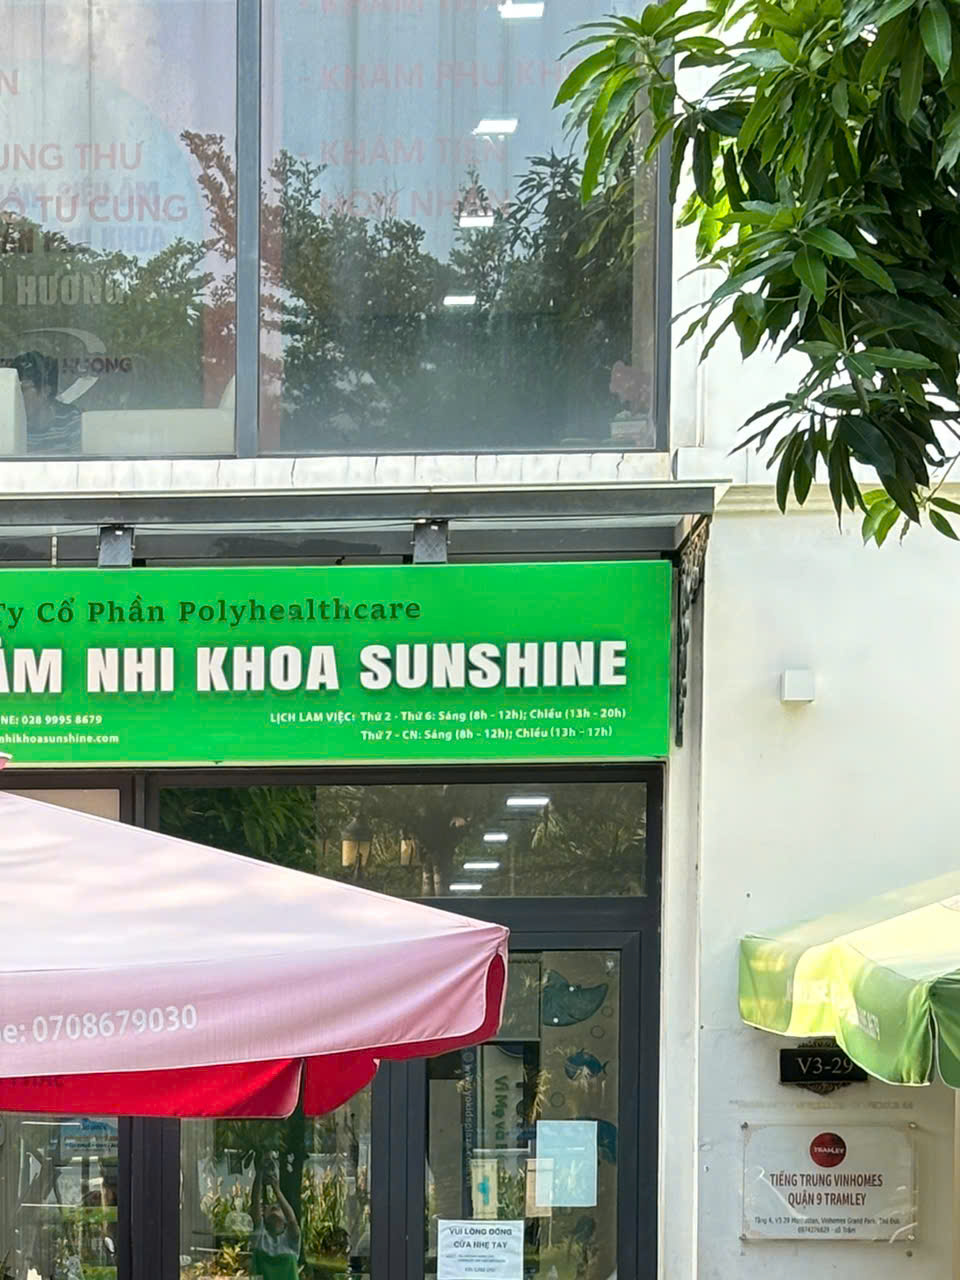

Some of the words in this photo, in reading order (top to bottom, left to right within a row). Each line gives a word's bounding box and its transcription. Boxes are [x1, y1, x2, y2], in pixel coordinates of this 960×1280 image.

[89, 195, 188, 222] CUNG
[36, 597, 76, 624] Cổ
[87, 595, 165, 624] Phần
[178, 597, 421, 629] Polyhealthcare
[86, 647, 174, 694] NHI
[196, 645, 340, 694] KHOA
[359, 640, 628, 691] SUNSHINE
[21, 714, 42, 725] 028
[45, 714, 72, 725] 9995
[75, 714, 103, 725] 8679
[384, 711, 392, 721] 2
[385, 730, 392, 740] 7
[32, 1004, 197, 1043] 0708679030
[796, 1056, 854, 1075] V3-29
[770, 1170, 798, 1187] TIẾNG
[800, 1173, 832, 1188] TRUNG
[834, 1173, 883, 1188] VINHOMES
[816, 1193, 822, 1206] 9
[825, 1193, 867, 1207] TRAMLEY
